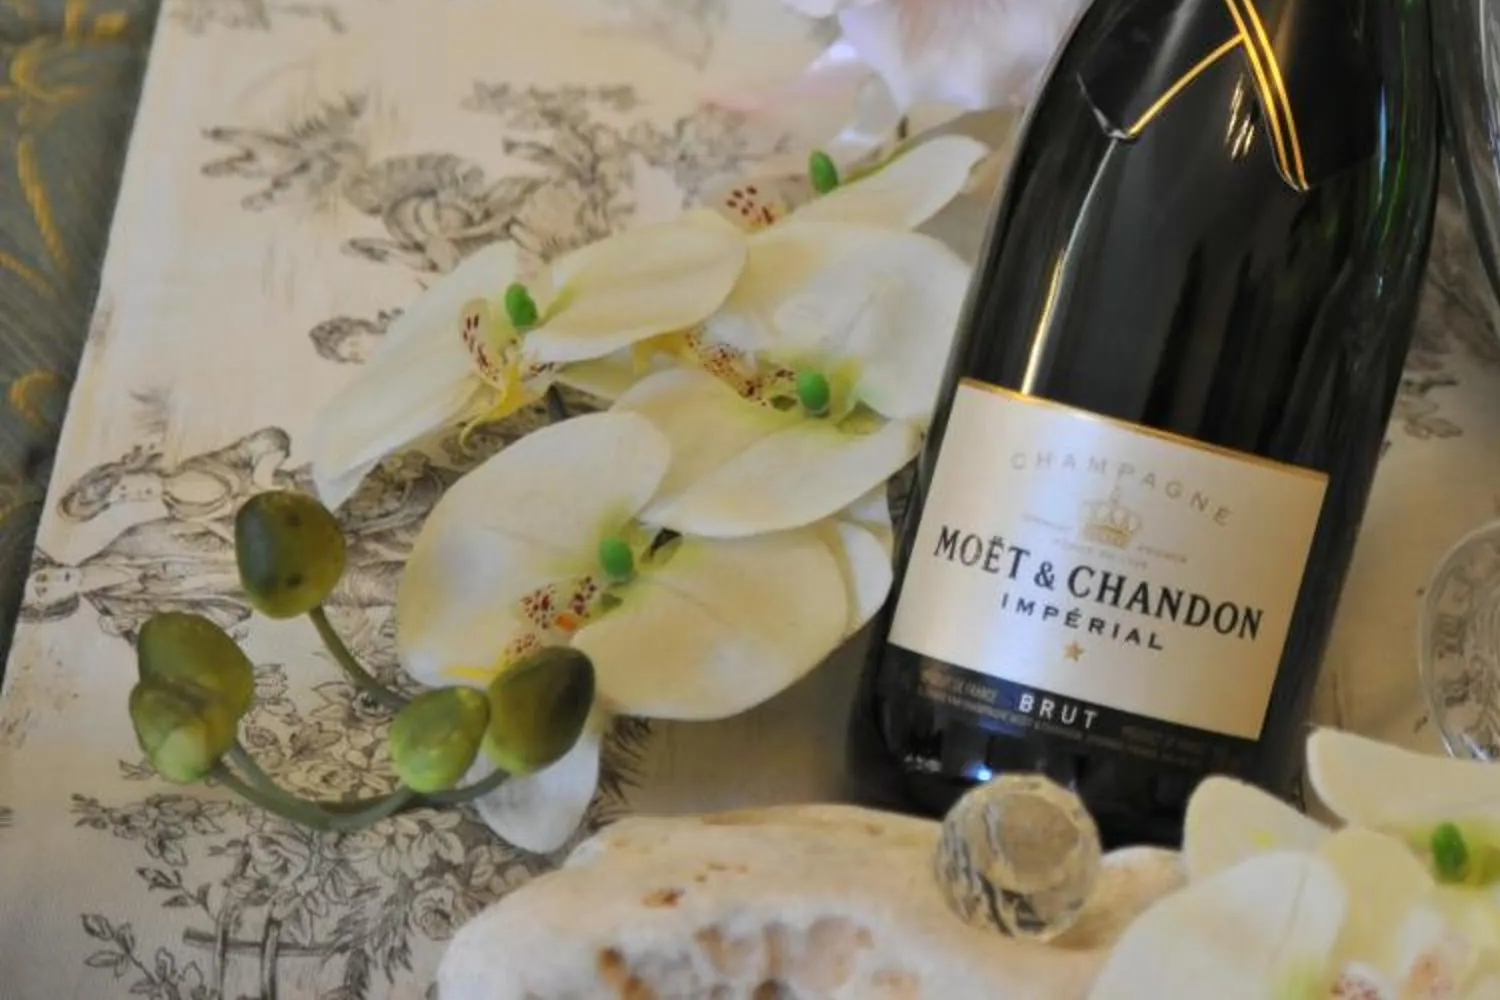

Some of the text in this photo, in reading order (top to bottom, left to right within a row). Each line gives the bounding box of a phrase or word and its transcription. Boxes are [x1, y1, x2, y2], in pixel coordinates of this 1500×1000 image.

[1011, 450, 1234, 525] CHAMPAGNE
[933, 525, 1032, 581] MOËT
[1033, 560, 1056, 591] &
[1067, 564, 1264, 641] CHANDON
[1001, 593, 1164, 650] IMPÉRIAL
[1018, 692, 1098, 729] BRUT
